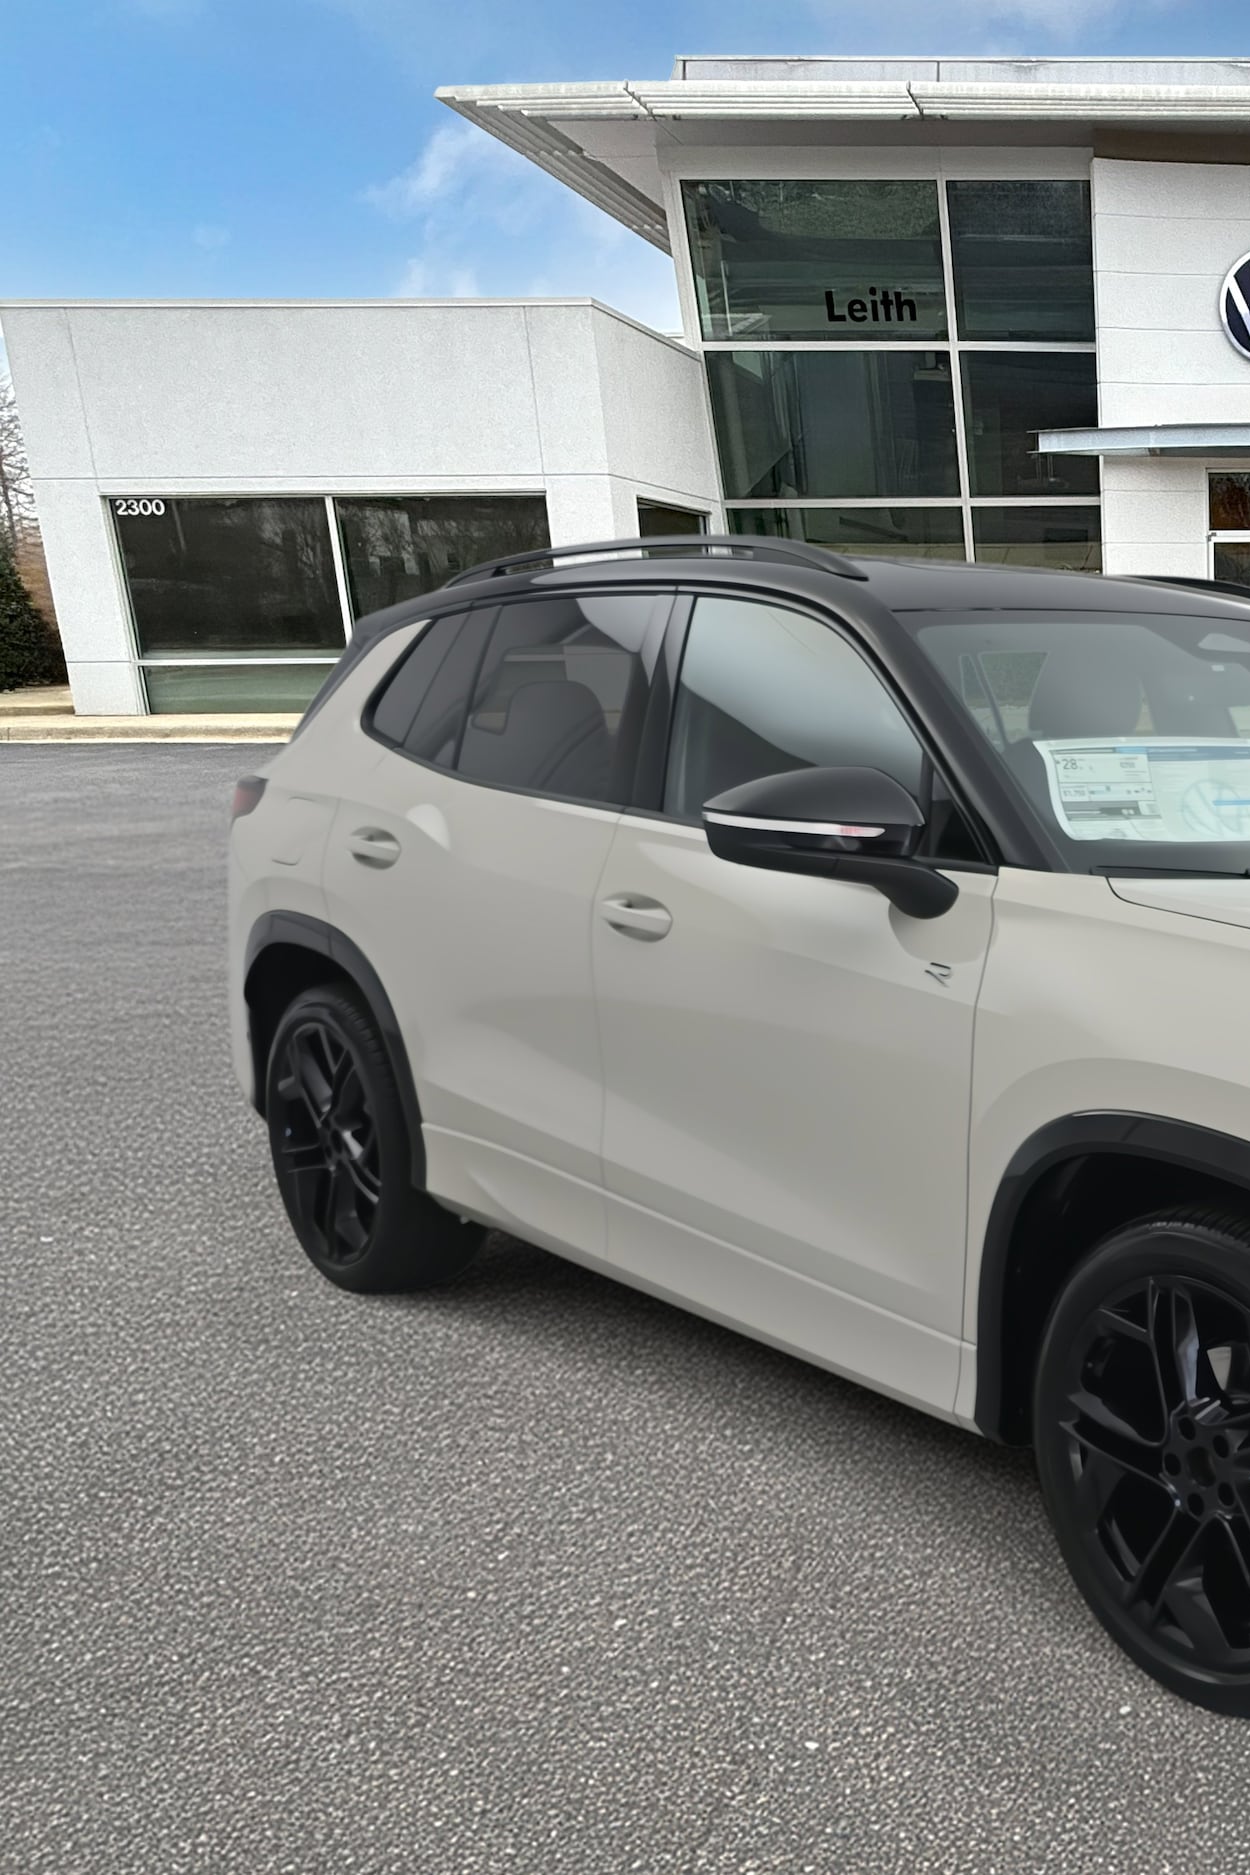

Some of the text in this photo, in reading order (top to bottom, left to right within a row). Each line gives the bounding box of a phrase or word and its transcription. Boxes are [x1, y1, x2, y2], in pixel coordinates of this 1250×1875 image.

[825, 286, 917, 322] Leith
[115, 499, 165, 515] 2300
[1062, 759, 1079, 770] 28
